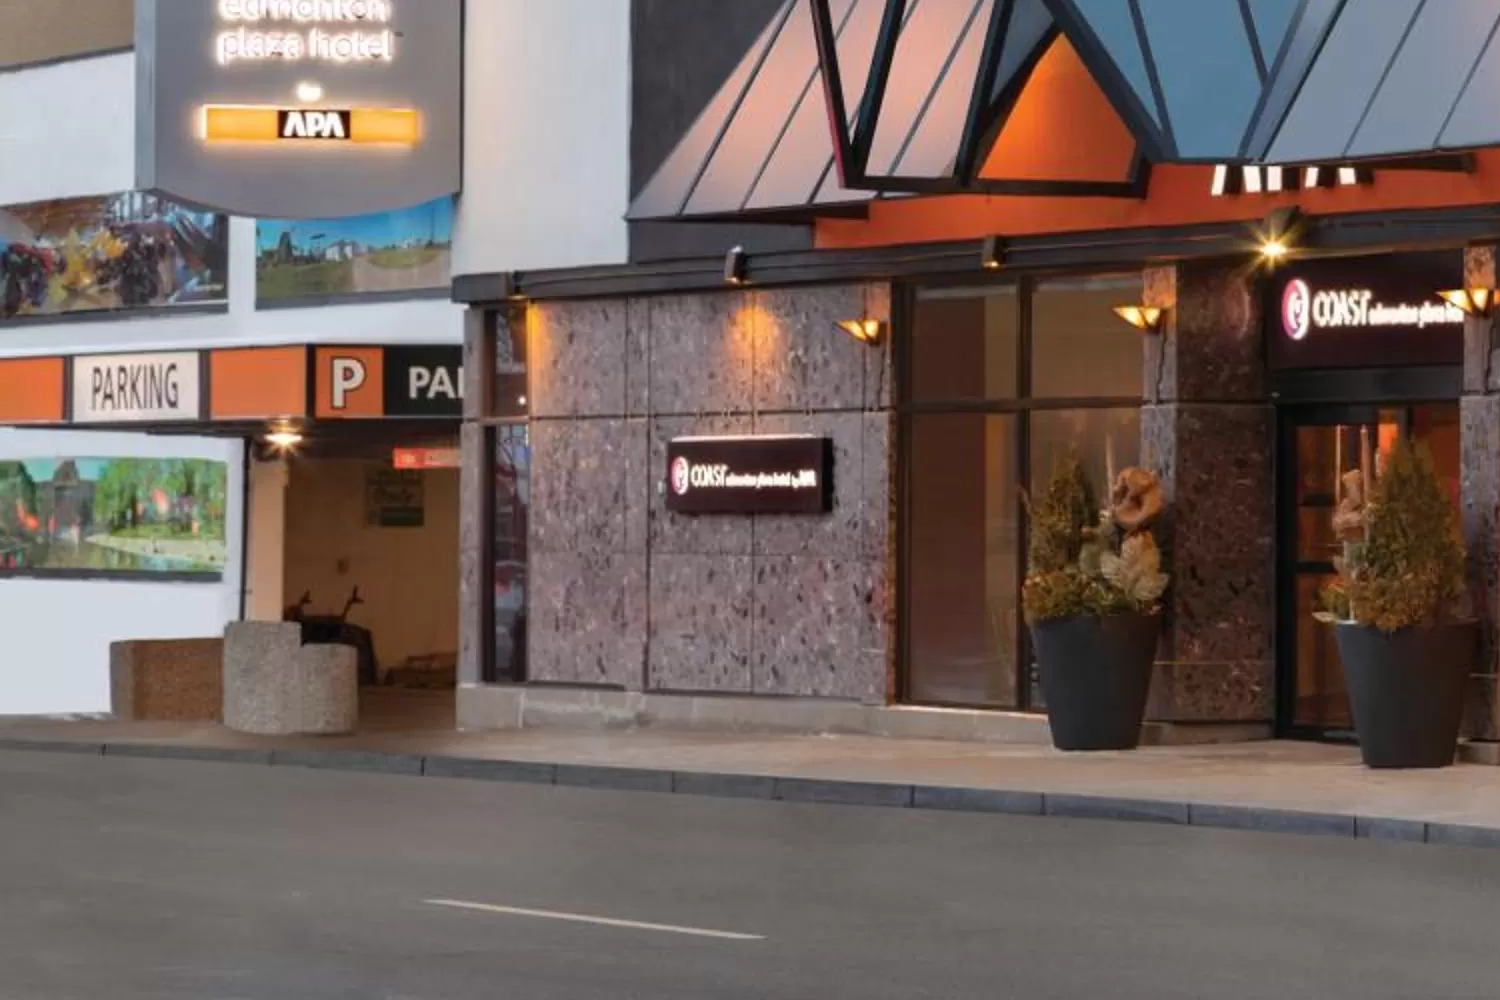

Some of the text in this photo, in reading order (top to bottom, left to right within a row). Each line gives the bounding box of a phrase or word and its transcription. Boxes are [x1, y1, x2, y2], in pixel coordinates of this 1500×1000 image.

[216, 27, 393, 65] plaza hotel
[283, 111, 345, 137] APA
[1312, 288, 1373, 328] COAST
[92, 363, 178, 410] PARKING
[330, 355, 367, 409] P
